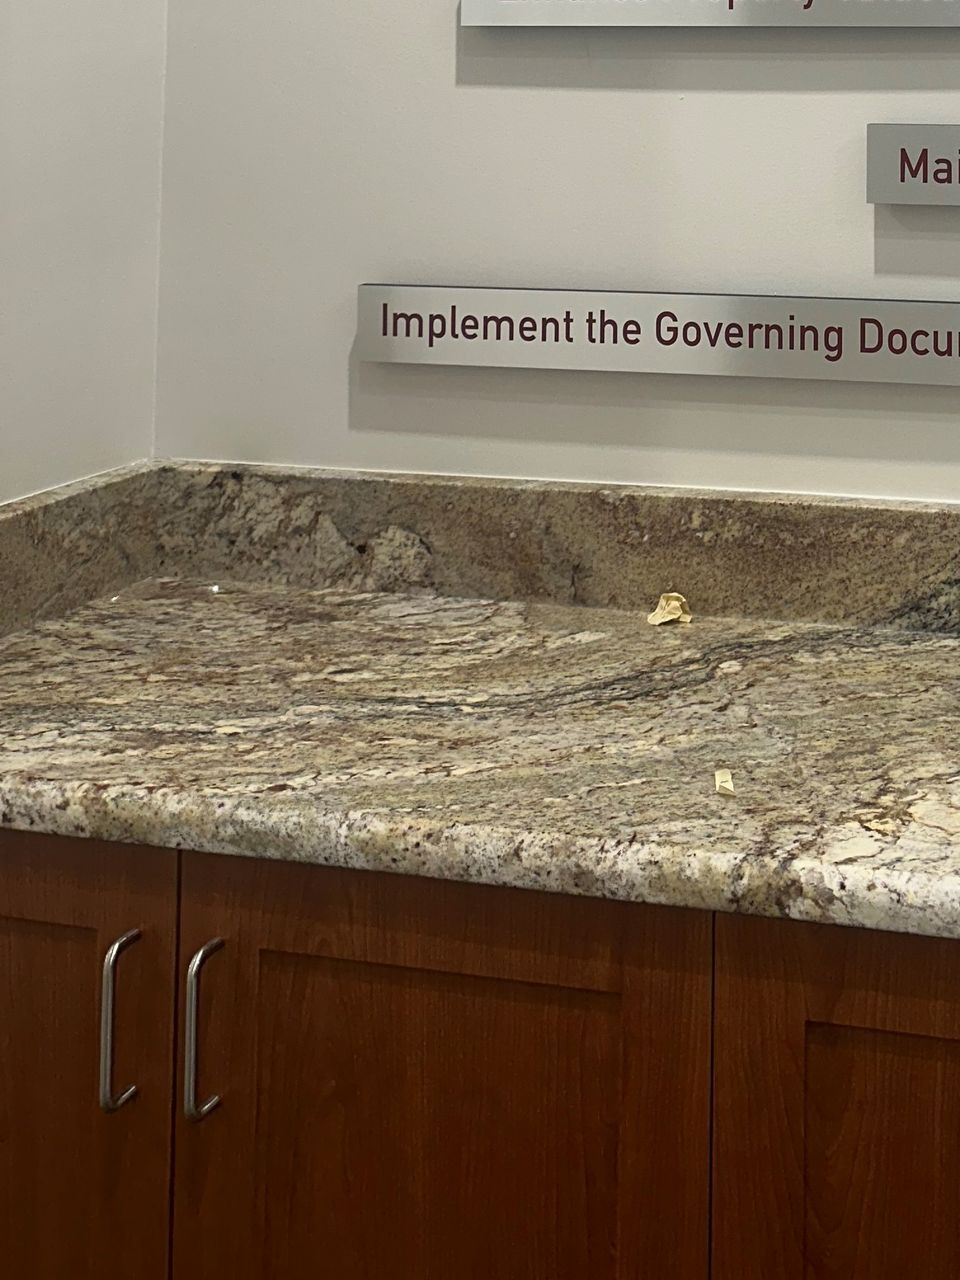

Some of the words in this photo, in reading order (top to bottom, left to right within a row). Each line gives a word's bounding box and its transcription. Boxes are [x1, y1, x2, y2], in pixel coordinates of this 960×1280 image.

[381, 303, 574, 348] Implement
[587, 311, 642, 347] the
[655, 312, 845, 362] Governing
